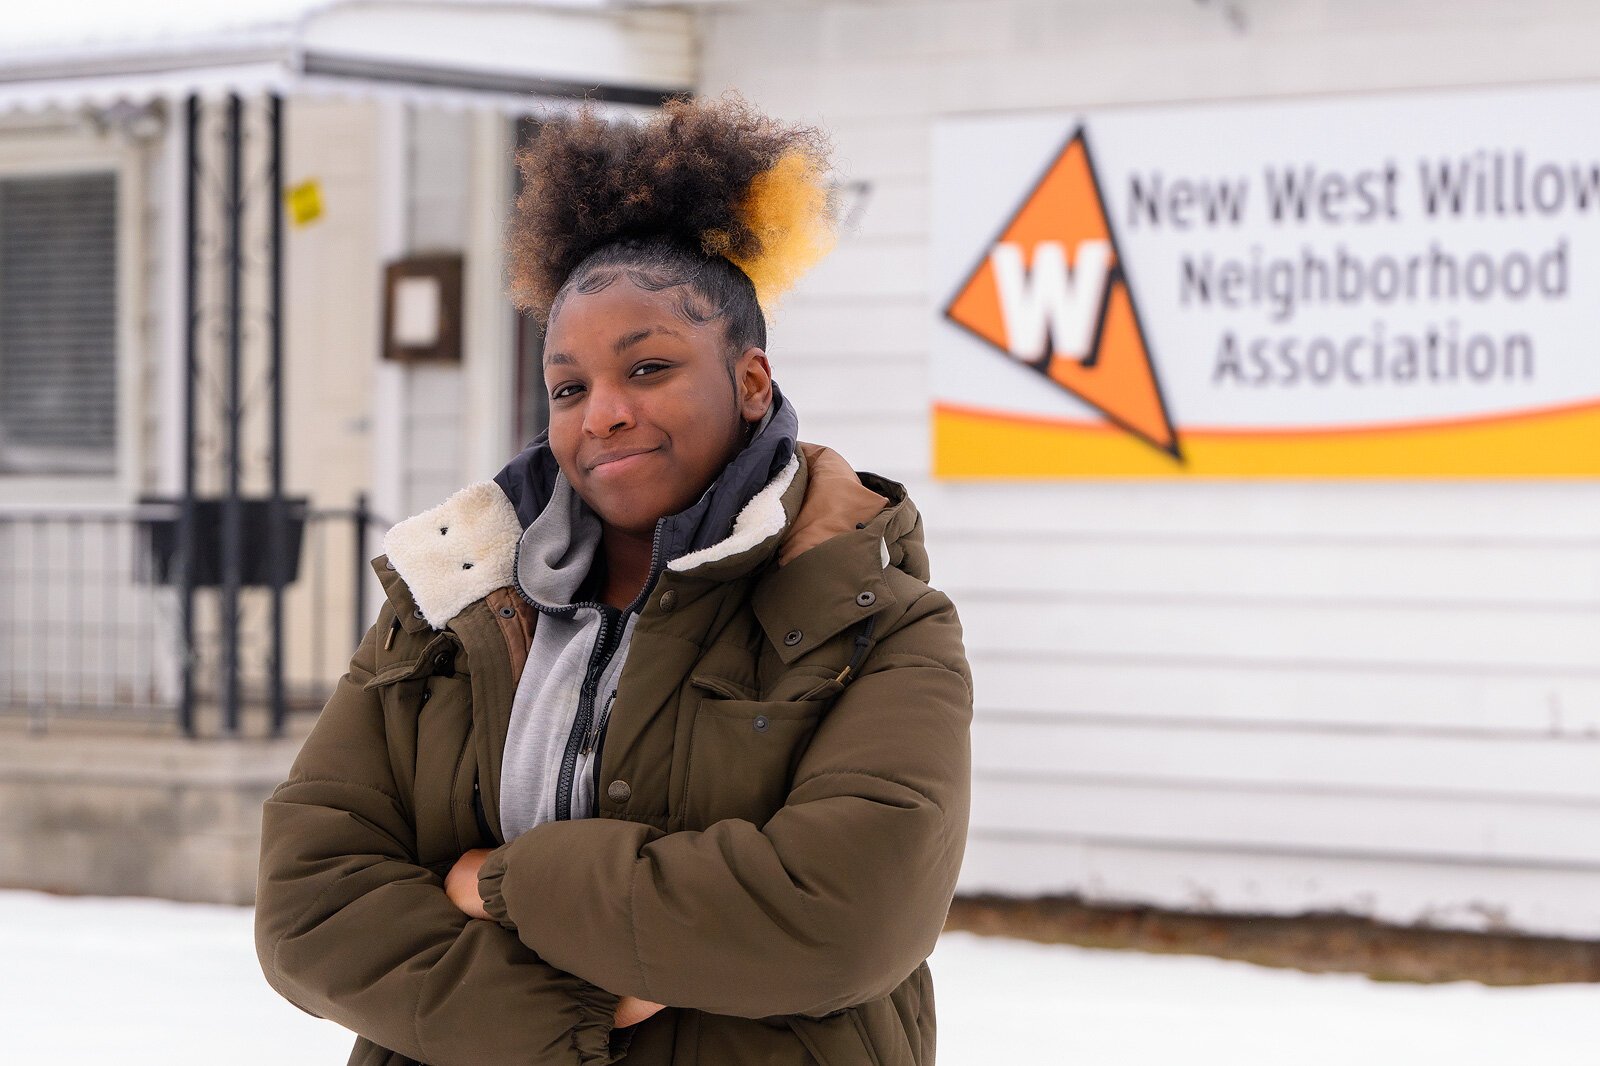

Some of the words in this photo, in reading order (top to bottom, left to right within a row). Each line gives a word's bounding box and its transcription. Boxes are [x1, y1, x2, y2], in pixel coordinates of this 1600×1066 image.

[1128, 173, 1247, 226] New
[1265, 163, 1400, 223] West
[991, 241, 1118, 367] W
[1181, 238, 1568, 321] Neighborhood
[1213, 323, 1534, 386] Association
